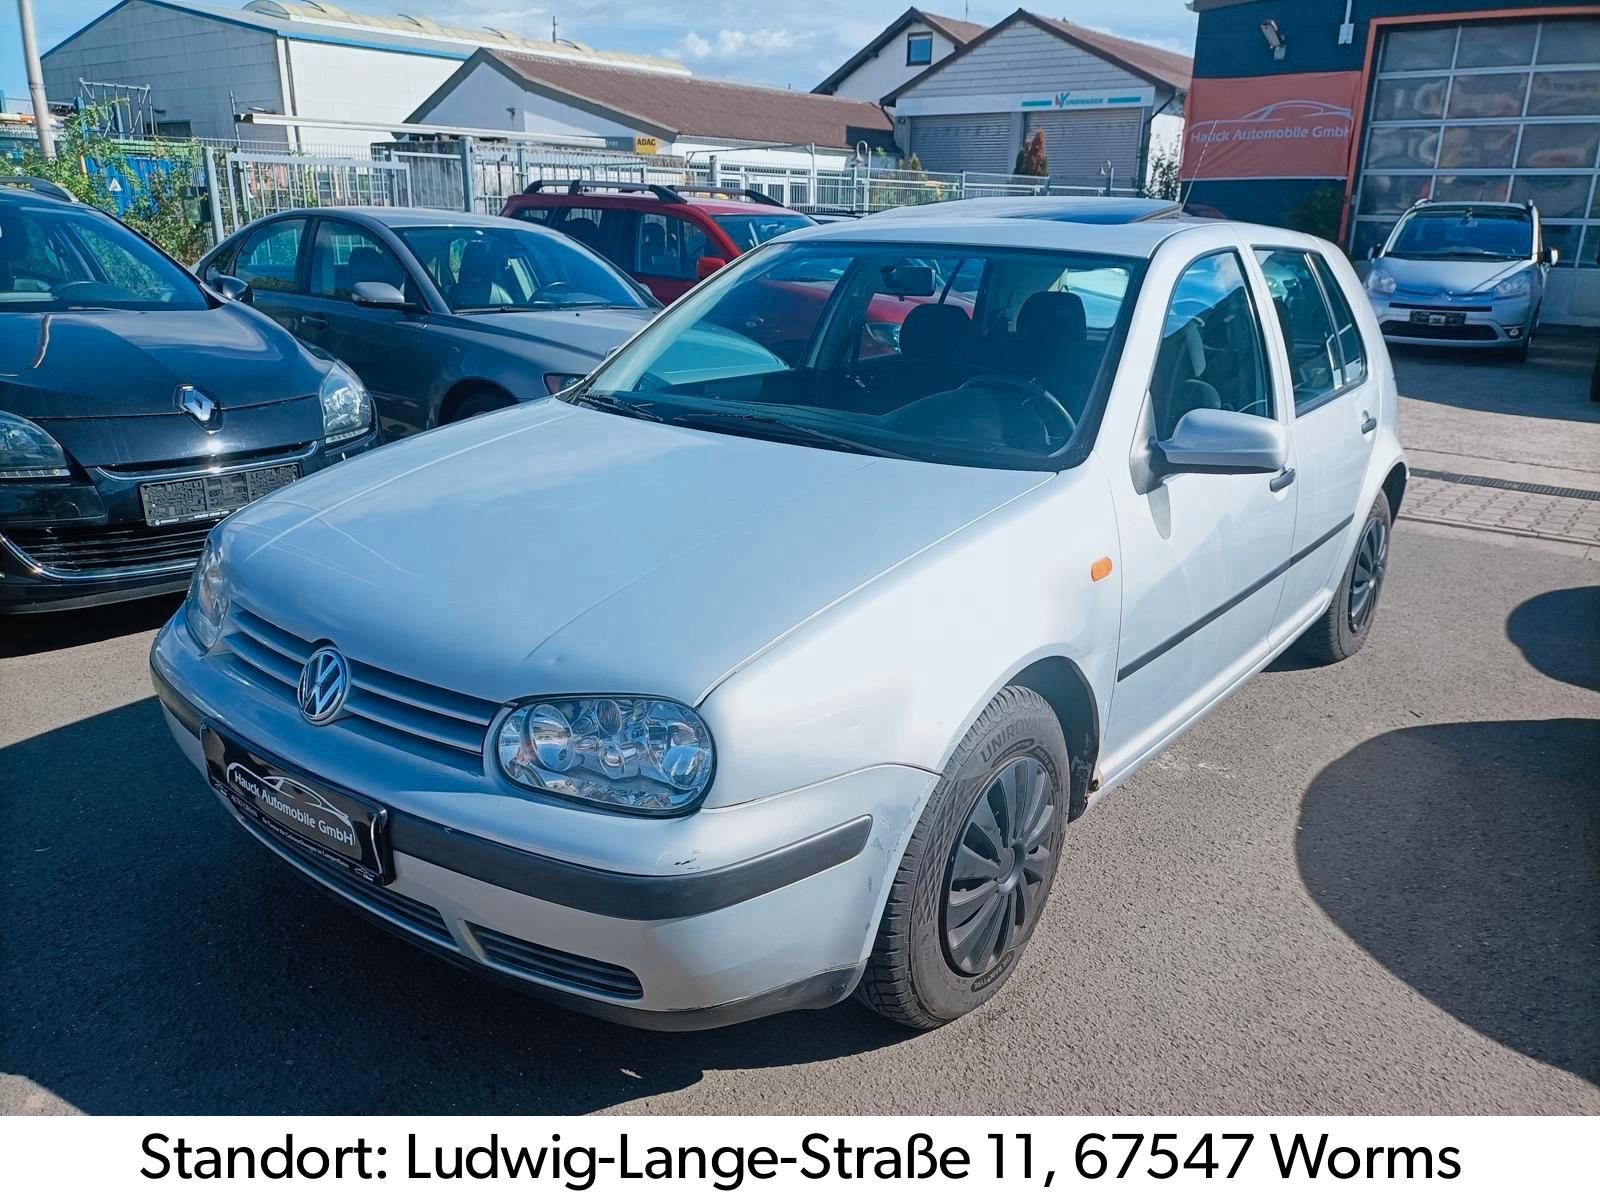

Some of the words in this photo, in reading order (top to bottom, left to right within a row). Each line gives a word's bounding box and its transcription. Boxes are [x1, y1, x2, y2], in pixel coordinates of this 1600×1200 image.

[637, 138, 656, 146] ADAC
[1190, 129, 1229, 143] Hauck
[1232, 127, 1308, 141] Automobile
[234, 770, 260, 798] Hauck
[261, 789, 316, 828] Automobile
[318, 820, 353, 846] GmbH
